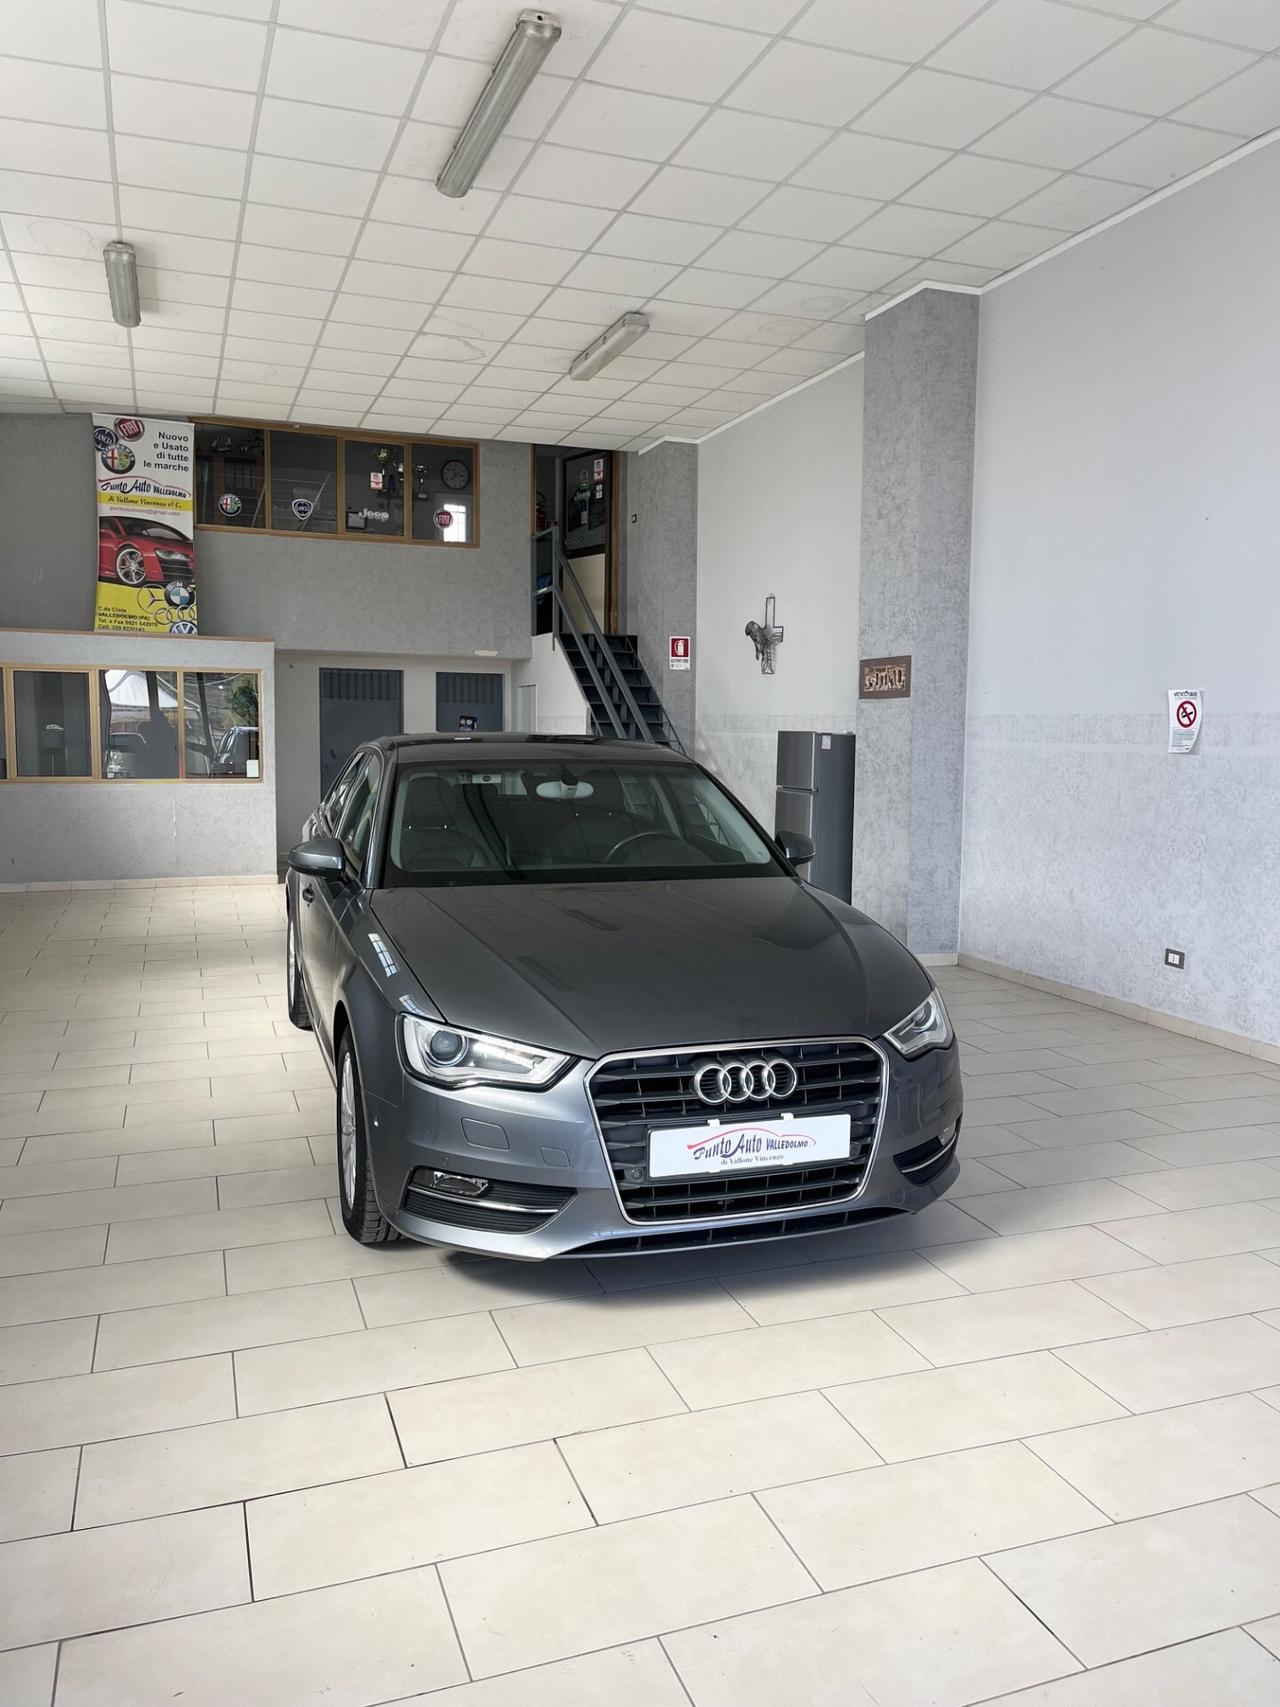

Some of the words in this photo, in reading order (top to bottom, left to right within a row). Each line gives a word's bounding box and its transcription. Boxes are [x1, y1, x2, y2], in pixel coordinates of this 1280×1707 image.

[120, 421, 139, 436] FIAT
[158, 431, 189, 442] Nuovo
[162, 441, 189, 452] Usato
[156, 452, 165, 460] di
[168, 453, 189, 462] tutte
[143, 460, 152, 468] le
[154, 461, 189, 472] marche
[101, 480, 128, 491] Punto
[120, 479, 151, 494] Auto
[153, 485, 187, 498] VALLEDOLMO
[359, 508, 389, 522] Jeep
[693, 1137, 731, 1160] Punto
[720, 1133, 762, 1158] Auto
[766, 1138, 809, 1151] VALLEDOLMO
[729, 1156, 753, 1165] Vallone
[754, 1154, 784, 1163] Vincenzo
